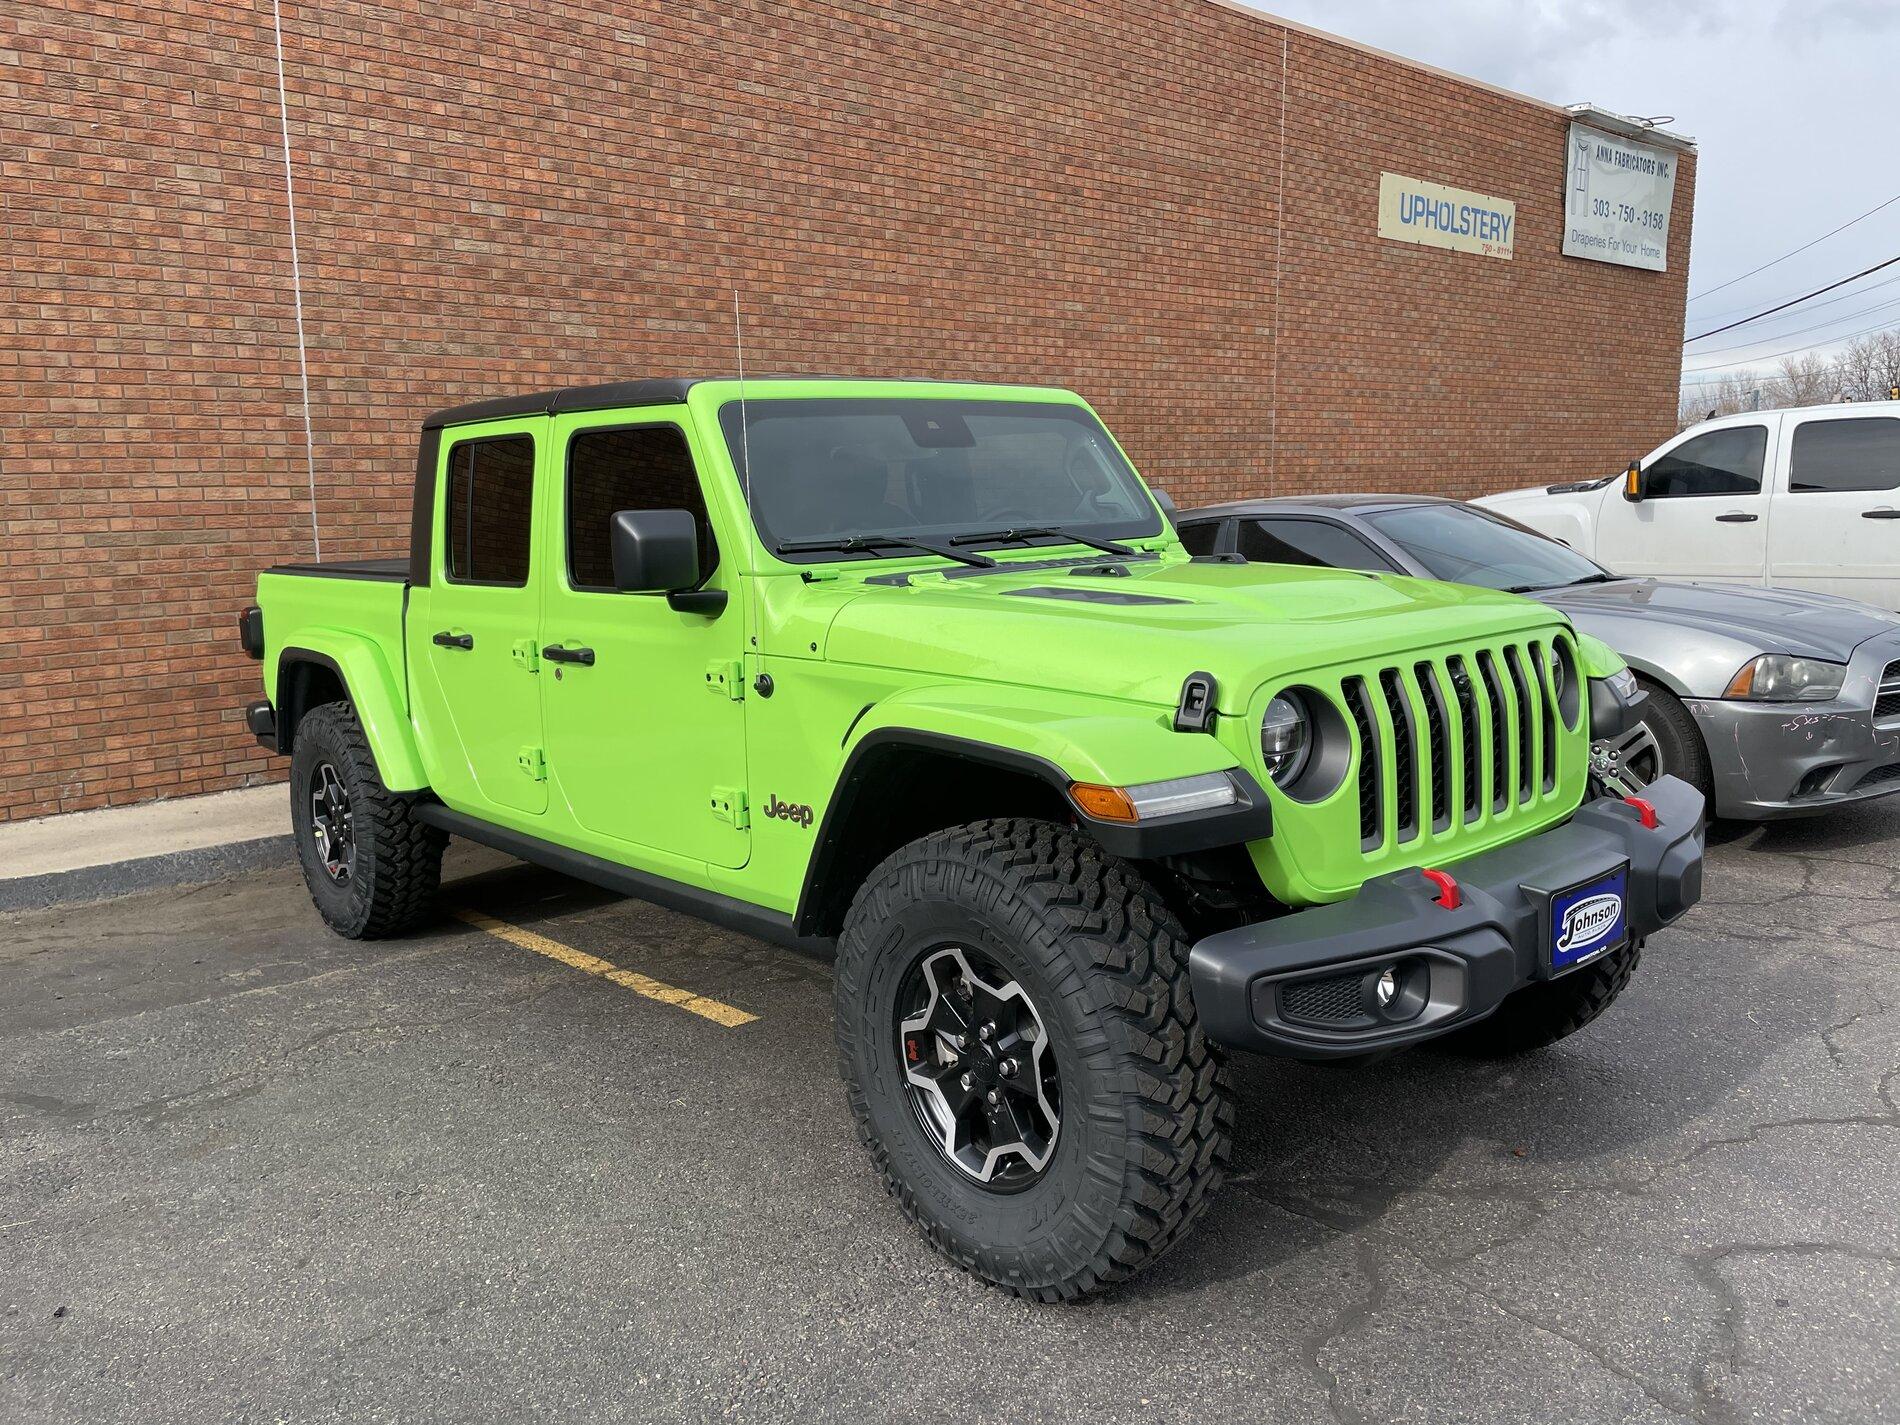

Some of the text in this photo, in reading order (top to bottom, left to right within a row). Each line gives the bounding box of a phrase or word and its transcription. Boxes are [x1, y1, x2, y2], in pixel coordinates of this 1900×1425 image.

[1595, 144, 1670, 179] ANNA FABRICATORS INC.
[1400, 192, 1512, 243] UPHOLSTERY
[1592, 198, 1610, 218] 303
[1618, 203, 1635, 223] 750
[1642, 210, 1664, 230] 3158
[1571, 229, 1661, 259] Draperies For Your Home
[763, 793, 814, 829] Jeep
[1559, 902, 1617, 948] Johnson
